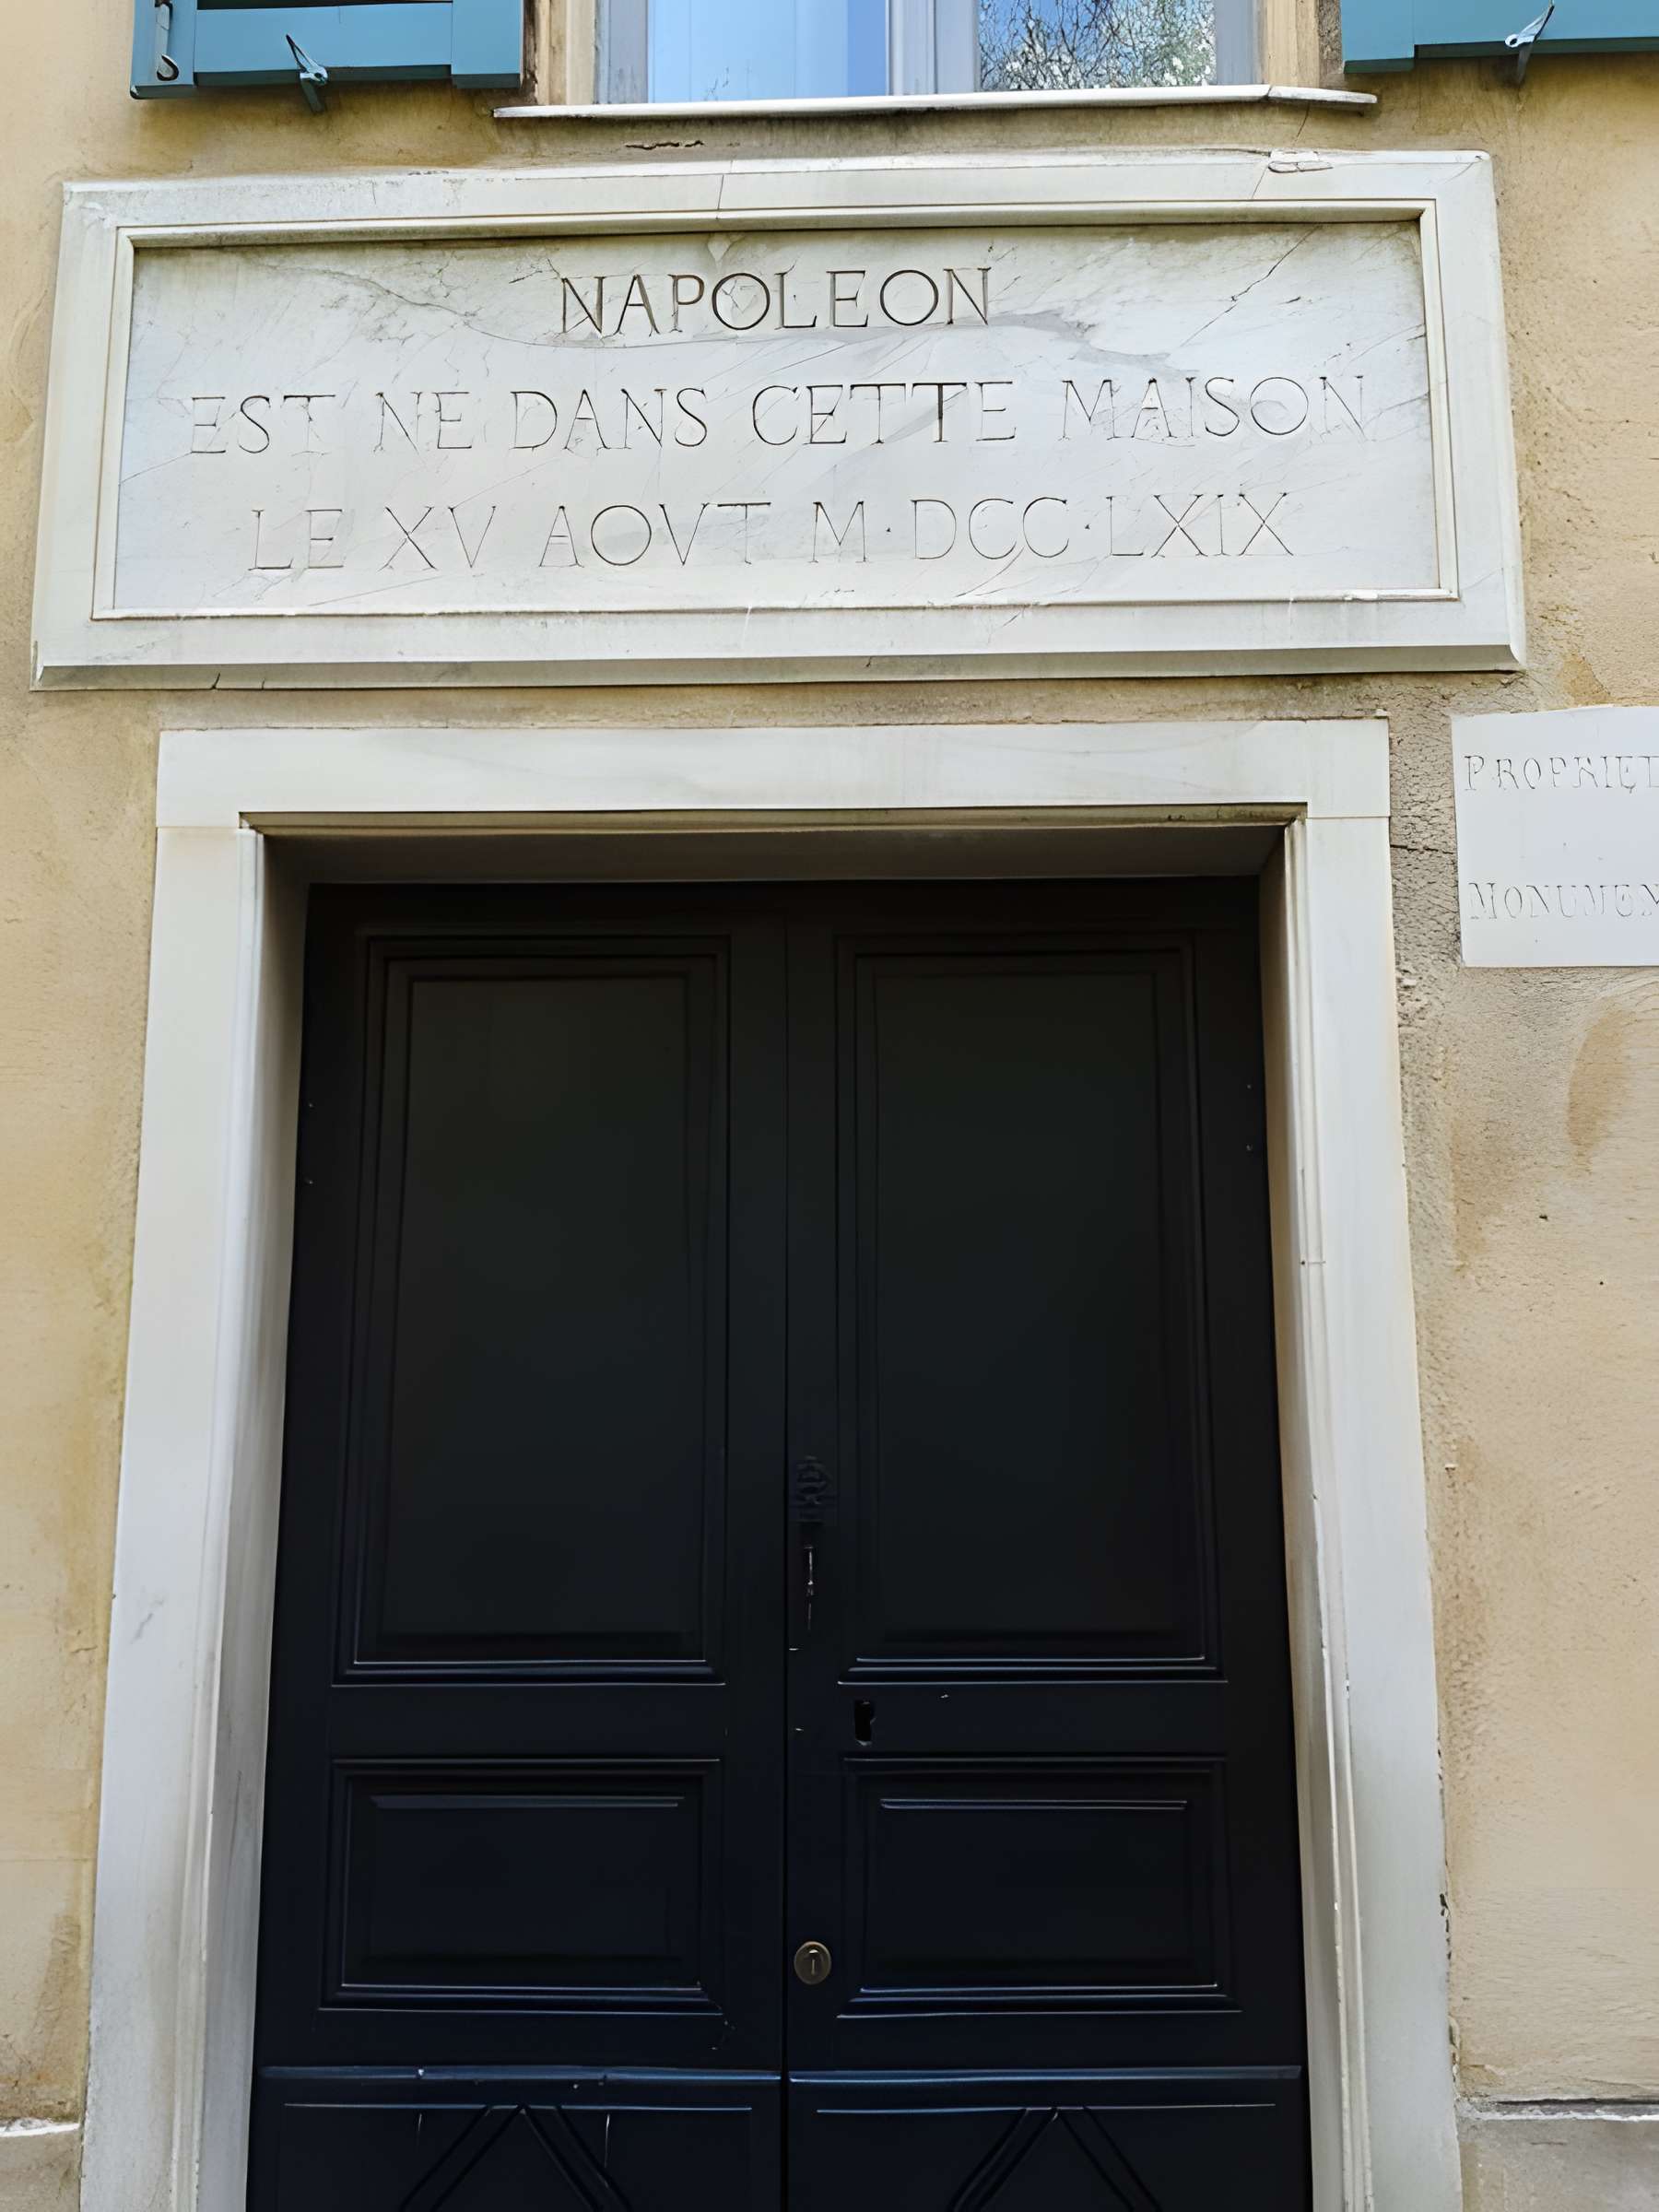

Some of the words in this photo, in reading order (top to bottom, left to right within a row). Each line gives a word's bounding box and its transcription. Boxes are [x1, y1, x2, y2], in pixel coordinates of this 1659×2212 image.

[559, 267, 992, 334] NAPOLEON
[191, 394, 337, 455] EST
[373, 391, 474, 453] NE
[510, 387, 708, 451] DANS
[752, 381, 1017, 446] CETTE
[1062, 375, 1370, 441] MAISON
[248, 508, 345, 571] LE
[378, 504, 498, 571] XV
[539, 500, 772, 568] AOVT
